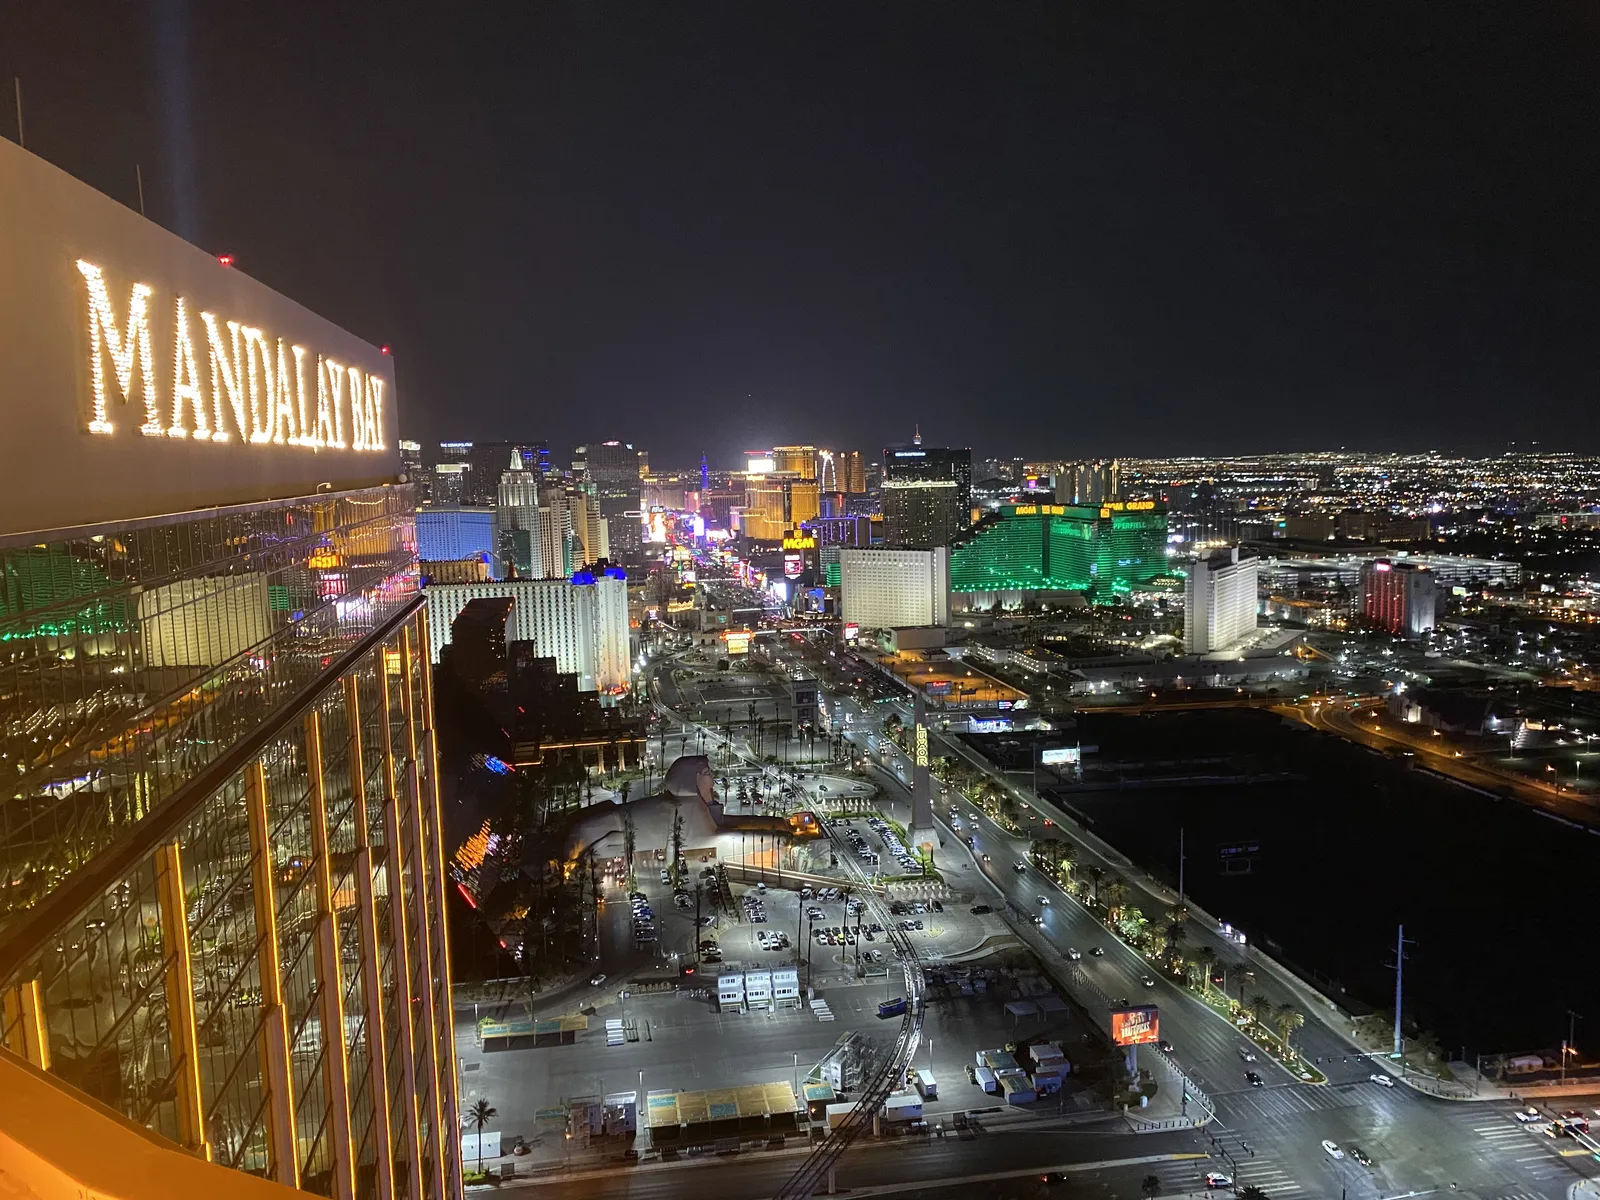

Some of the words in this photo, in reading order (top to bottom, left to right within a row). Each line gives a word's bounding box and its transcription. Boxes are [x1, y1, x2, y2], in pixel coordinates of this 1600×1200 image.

[76, 259, 345, 452] MANDALAY
[347, 367, 386, 451] BAY
[1016, 506, 1036, 515] MGM
[1126, 501, 1155, 510] GRAND
[783, 537, 815, 550] MGM
[916, 723, 928, 767] LUXOR
